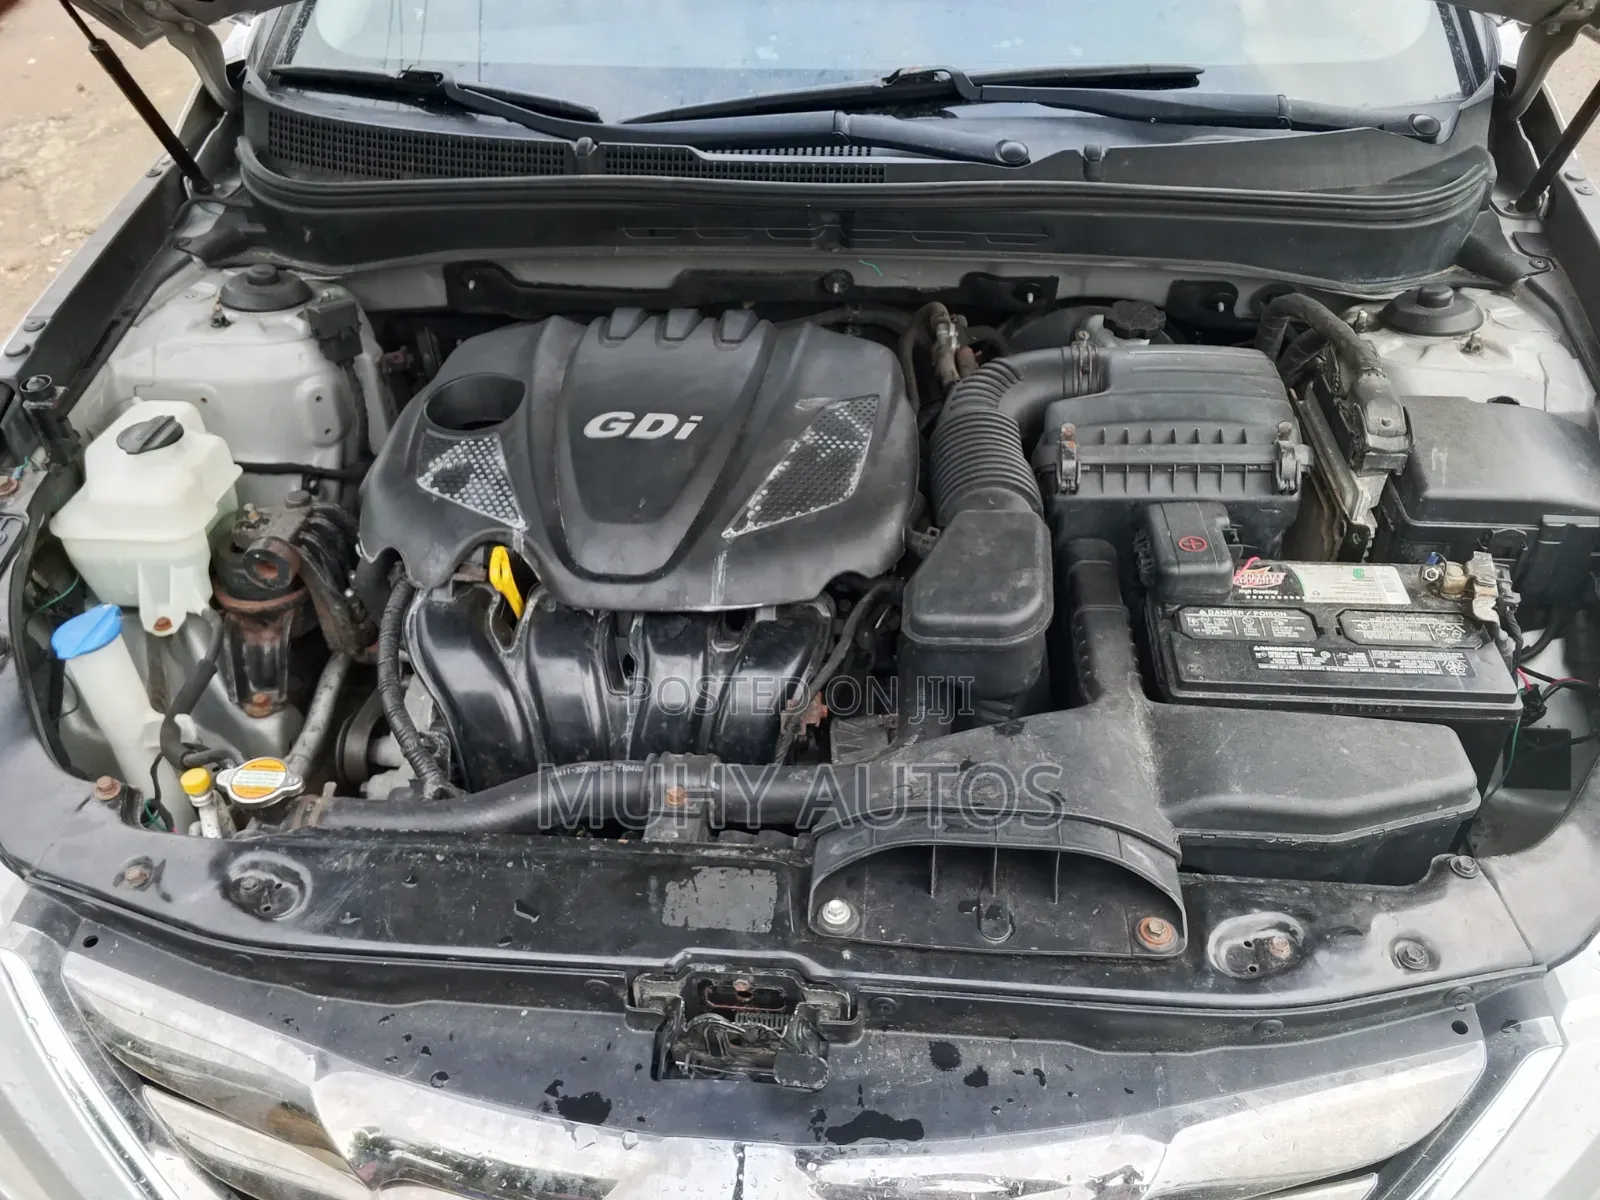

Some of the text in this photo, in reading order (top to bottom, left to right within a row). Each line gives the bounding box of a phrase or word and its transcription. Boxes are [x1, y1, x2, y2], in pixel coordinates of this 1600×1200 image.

[583, 411, 703, 440] GDi
[1207, 609, 1244, 617] DANGER
[1253, 610, 1287, 618] POISON
